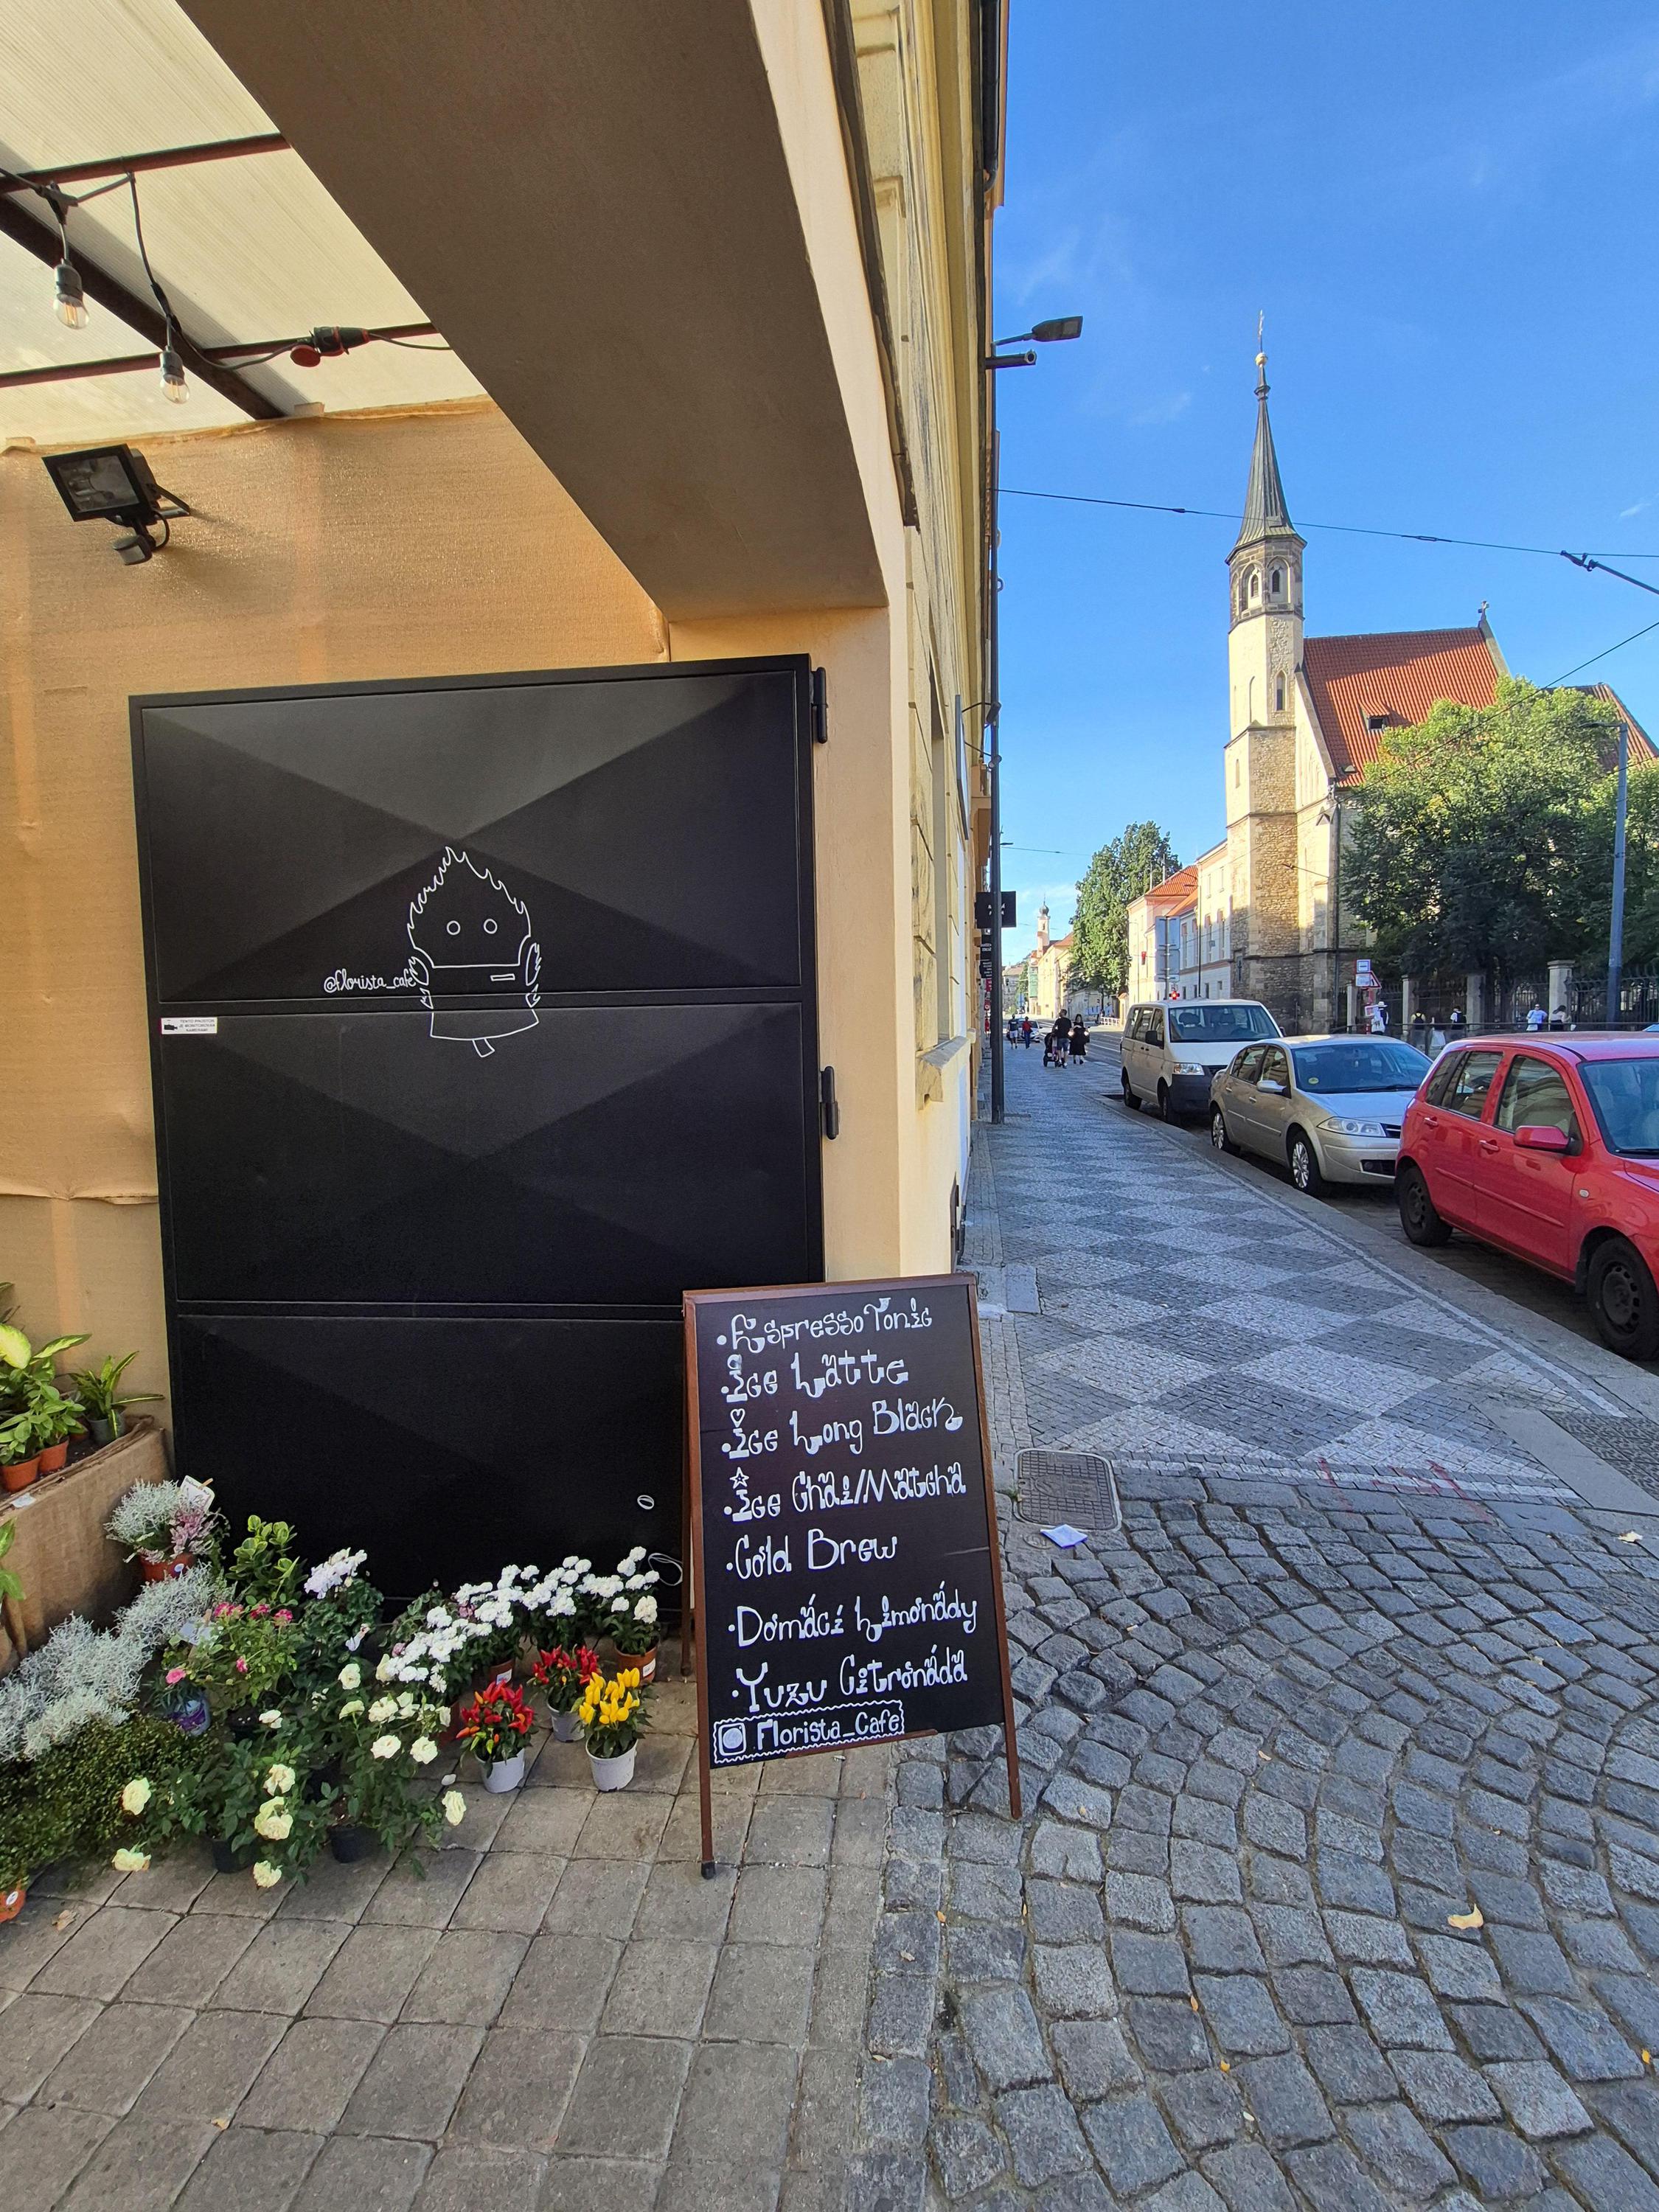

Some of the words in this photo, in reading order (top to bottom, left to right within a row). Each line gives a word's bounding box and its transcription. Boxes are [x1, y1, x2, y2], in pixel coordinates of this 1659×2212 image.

[731, 1310, 864, 1354] Espresso
[863, 1298, 933, 1331] Tonic
[726, 1370, 779, 1403] Ice
[790, 1349, 909, 1398] Latte
[728, 1427, 779, 1459] Ice
[790, 1410, 863, 1455] Long
[872, 1397, 964, 1435] Black
[732, 1489, 781, 1522] Ice
[736, 1534, 792, 1579] Cold
[808, 1528, 898, 1570] Brew
[737, 1594, 844, 1647] Domácí
[736, 1662, 827, 1712] Yuzu
[840, 1644, 968, 1695] Citronáda
[757, 1710, 900, 1750] Florista_Cafe
